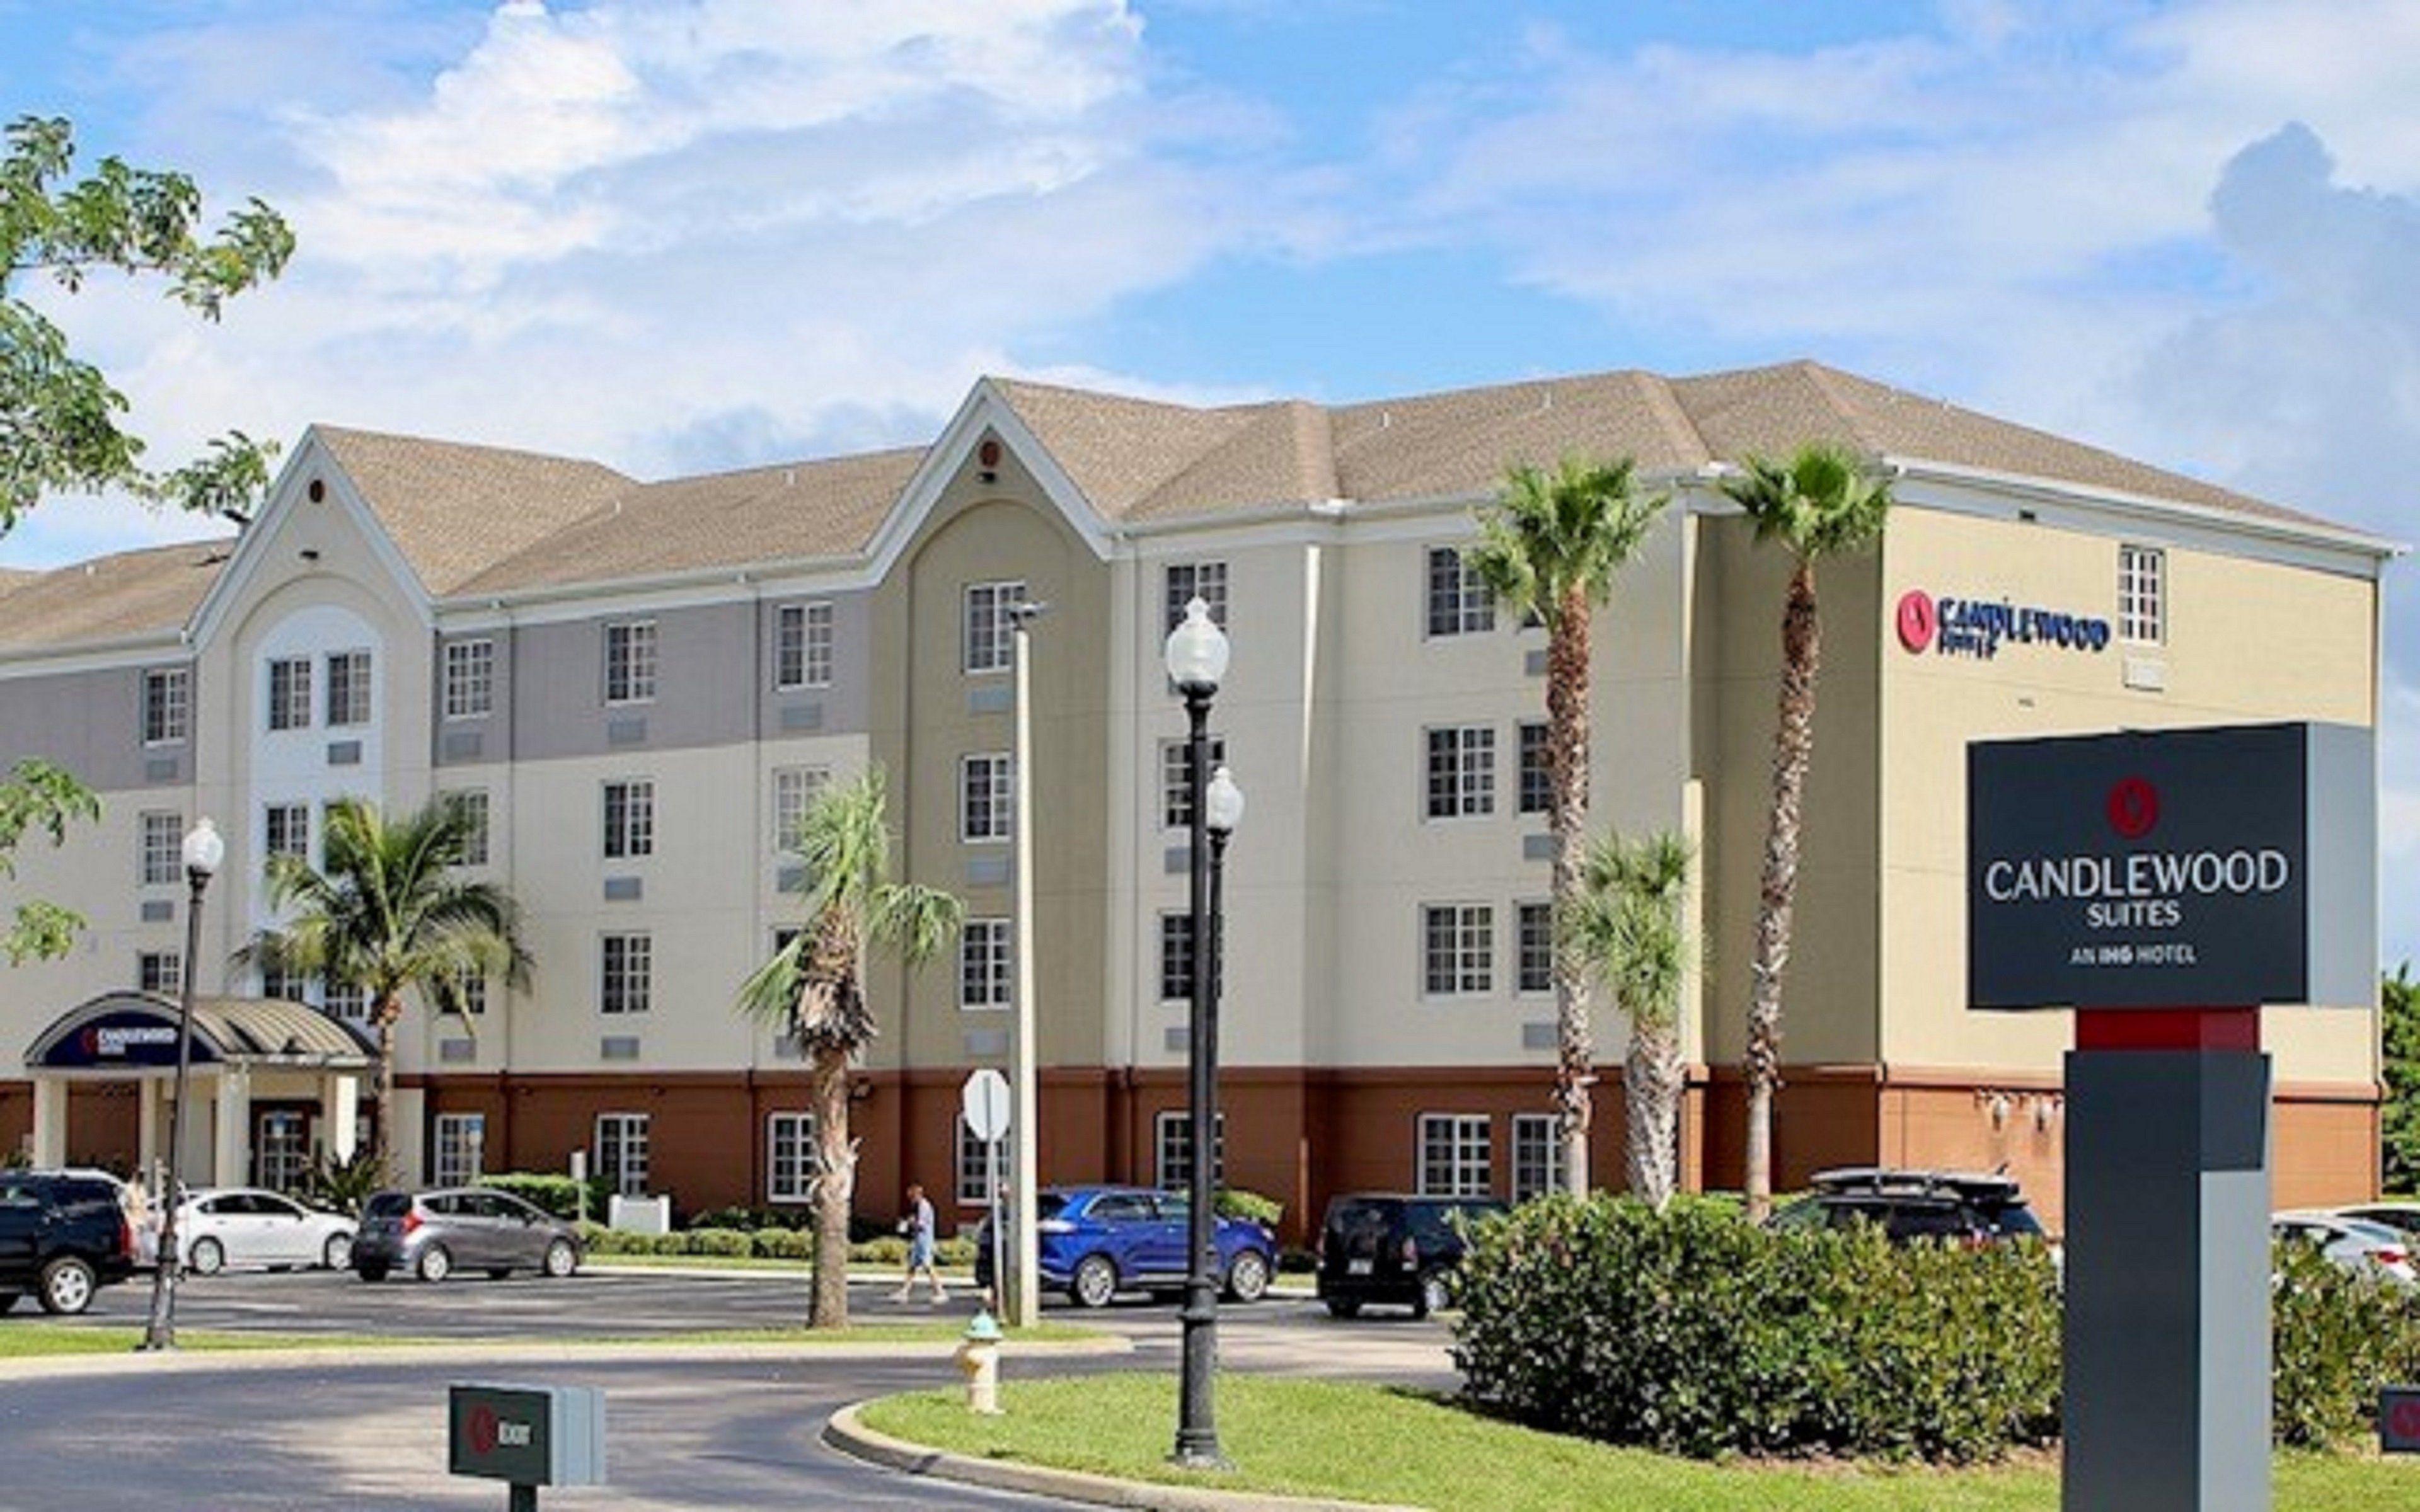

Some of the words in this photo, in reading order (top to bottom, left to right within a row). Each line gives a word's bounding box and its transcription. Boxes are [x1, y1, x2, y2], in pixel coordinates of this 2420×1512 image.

[1939, 597, 2110, 651] CANDLEWOOD
[1985, 849, 2290, 901] CANDLEWOOD
[2086, 900, 2182, 927] SUITES
[2069, 946, 2096, 965] AN
[2136, 944, 2197, 965] HOTEL
